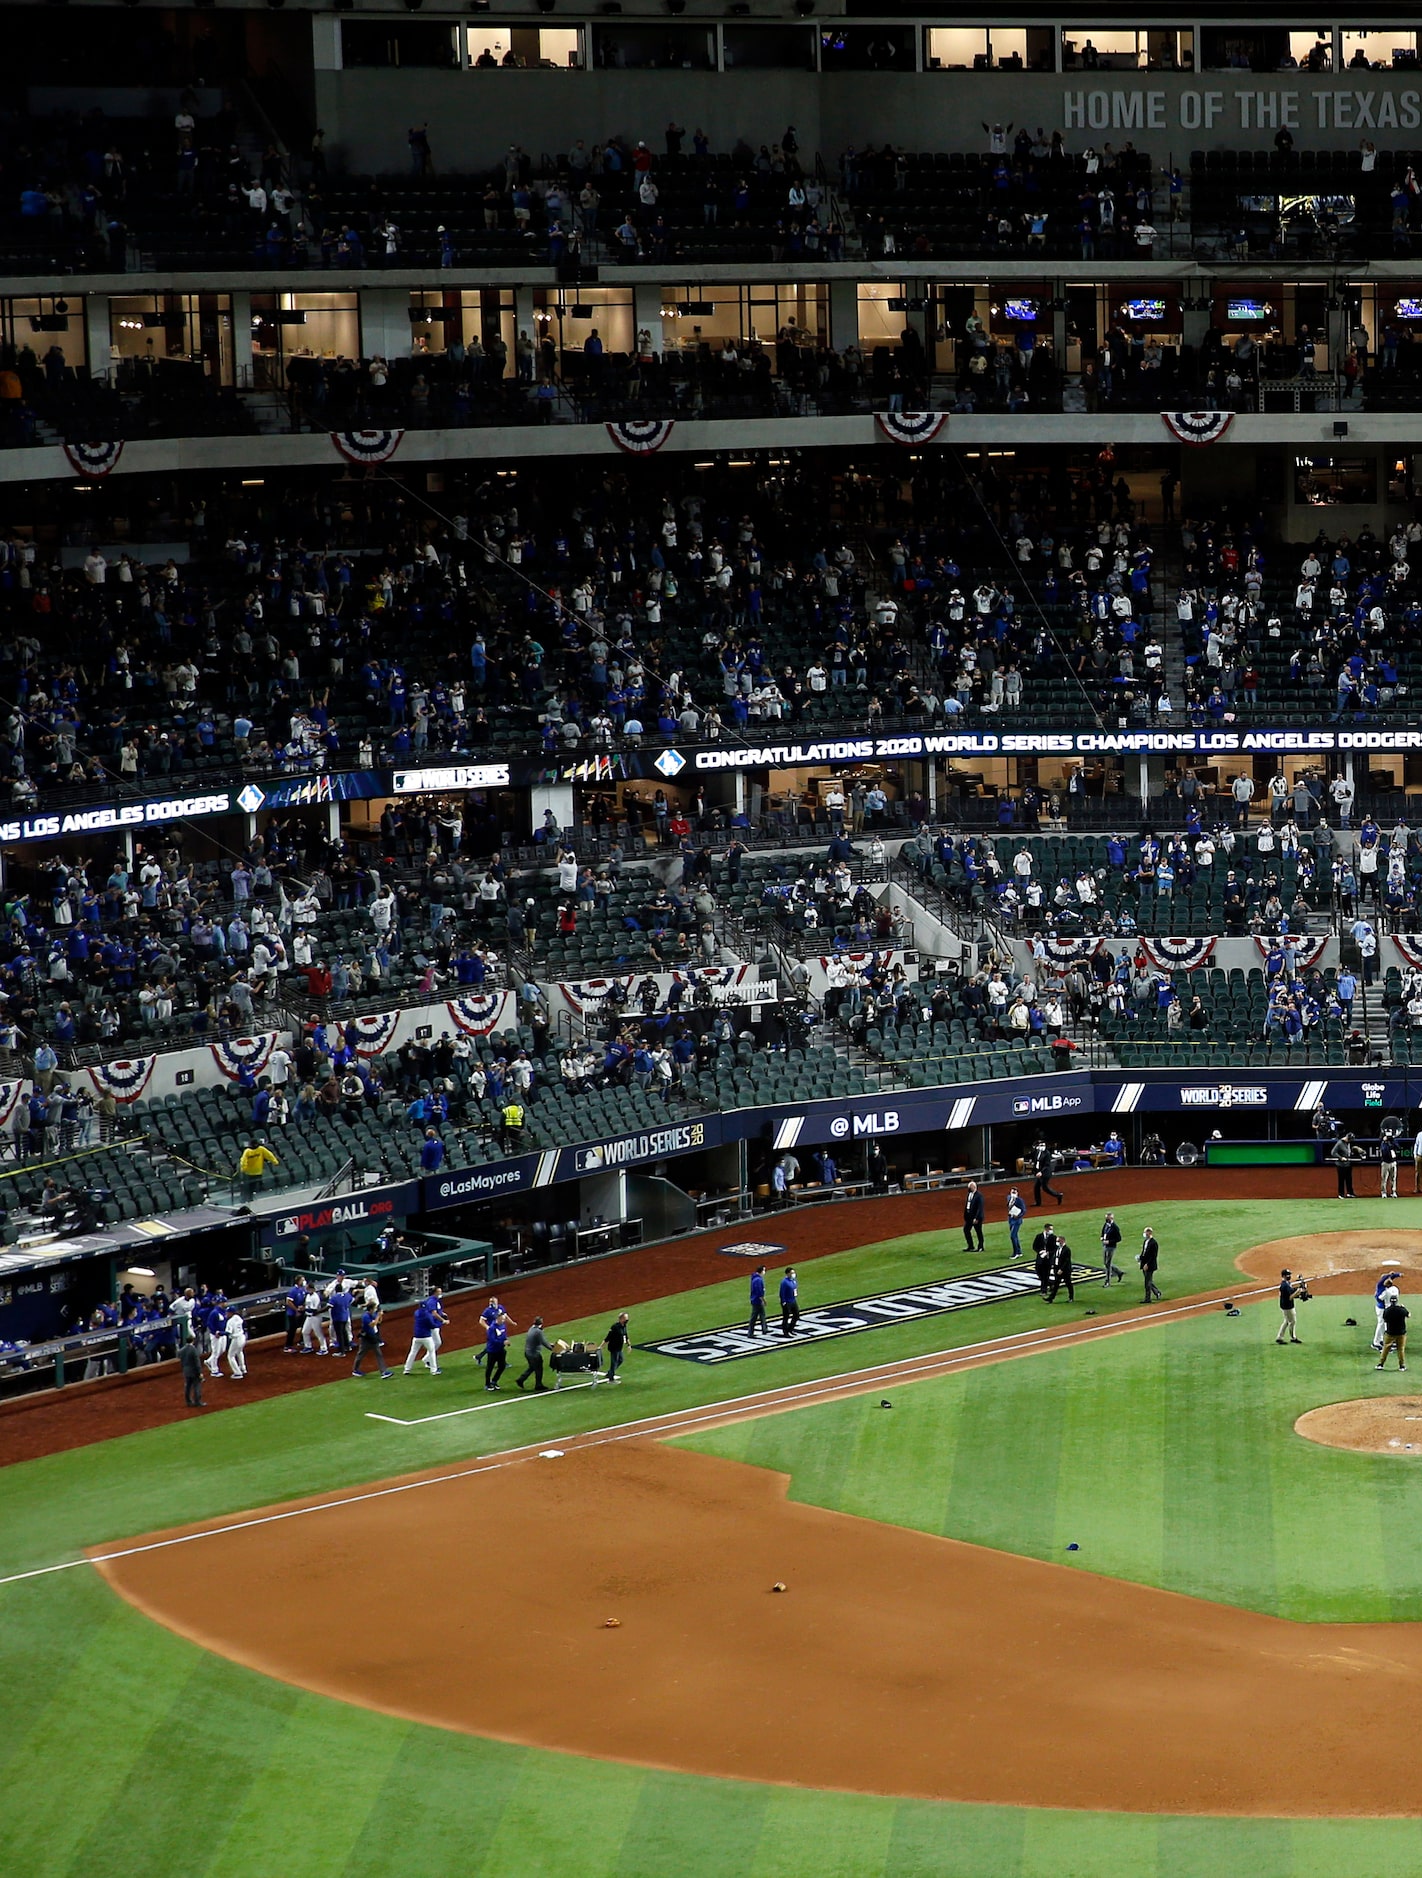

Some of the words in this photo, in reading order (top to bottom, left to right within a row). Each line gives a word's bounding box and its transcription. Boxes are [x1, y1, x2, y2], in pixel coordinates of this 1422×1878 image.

[1063, 90, 1166, 130] HOME
[1179, 90, 1223, 130] OF
[1234, 90, 1299, 130] THE
[1312, 90, 1421, 130] TEXAS
[695, 740, 874, 769] CONGRATULATIONS
[875, 736, 923, 756] 2020
[924, 735, 998, 753] WORLD
[1000, 734, 1073, 752] SERIES
[1076, 733, 1196, 750] CHAMPIONS
[1199, 732, 1240, 749] LOS
[1241, 732, 1335, 749] ANGELES
[23, 817, 60, 838] LOS
[62, 805, 145, 832] ANGELES
[146, 794, 230, 821] DODGERS
[1219, 1084, 1232, 1093] 20
[1361, 1083, 1386, 1092] Globe
[1365, 1091, 1381, 1099] Life
[1031, 1095, 1062, 1112] MLB
[1062, 1095, 1081, 1108] App
[1180, 1089, 1219, 1104] WORLD
[1231, 1088, 1268, 1102] SERIES
[1219, 1099, 1232, 1108] 20
[1364, 1098, 1383, 1107] Field
[690, 1123, 704, 1136] 20
[603, 1136, 649, 1166] WORLD
[649, 1126, 691, 1156] SERIES
[690, 1134, 704, 1147] 20
[439, 1168, 521, 1198] @LasMayores
[300, 1200, 393, 1231] PLAYBALL.ORG
[17, 1281, 44, 1295] @MLB
[853, 1270, 1042, 1318] WORLD
